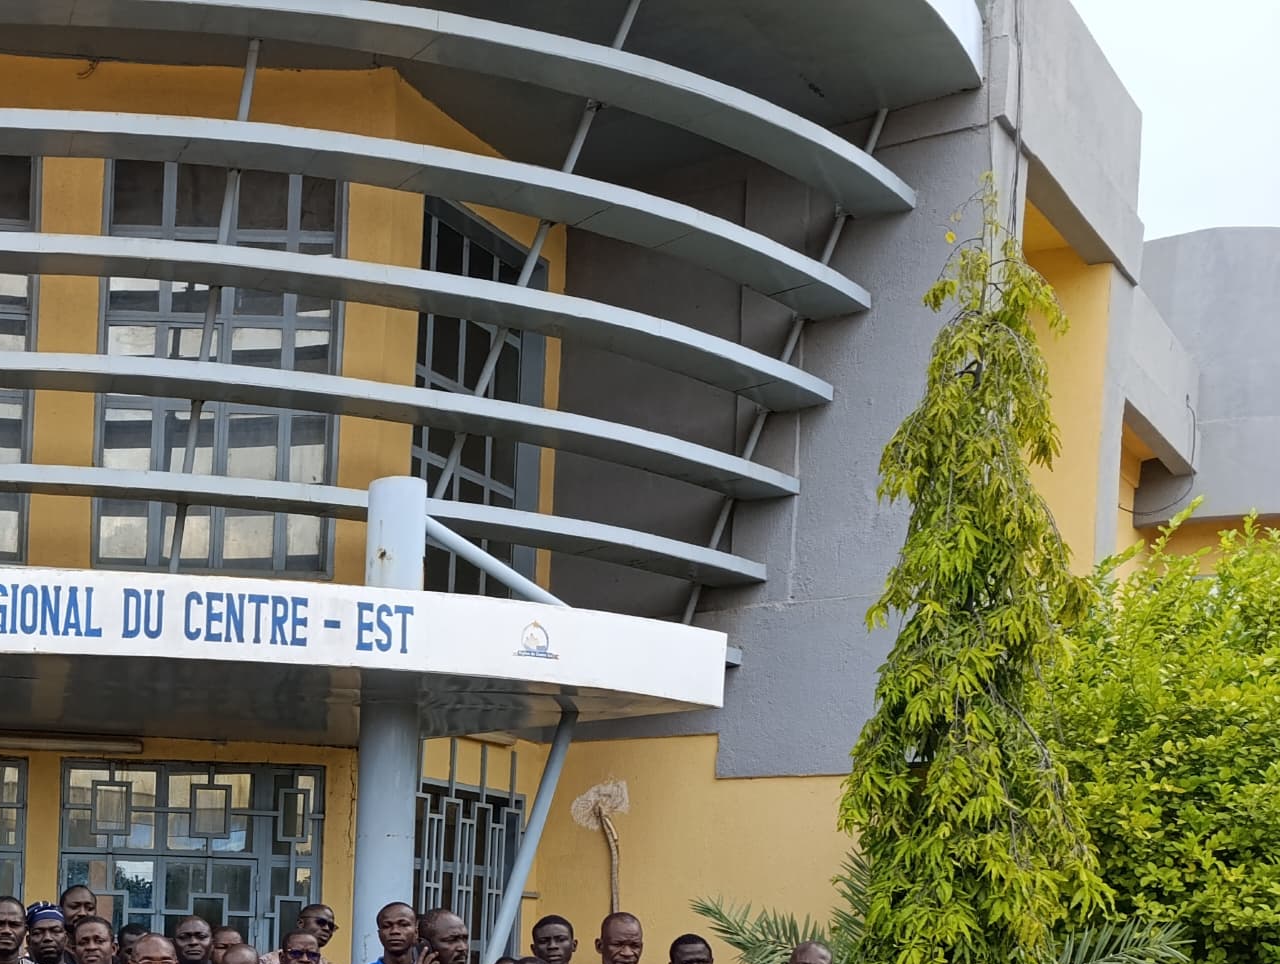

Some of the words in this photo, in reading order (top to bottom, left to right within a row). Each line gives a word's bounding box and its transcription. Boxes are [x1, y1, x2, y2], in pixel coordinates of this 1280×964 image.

[121, 588, 165, 639] DU
[184, 591, 309, 647] CENTRE
[324, 619, 341, 629] -
[356, 601, 415, 654] EST
